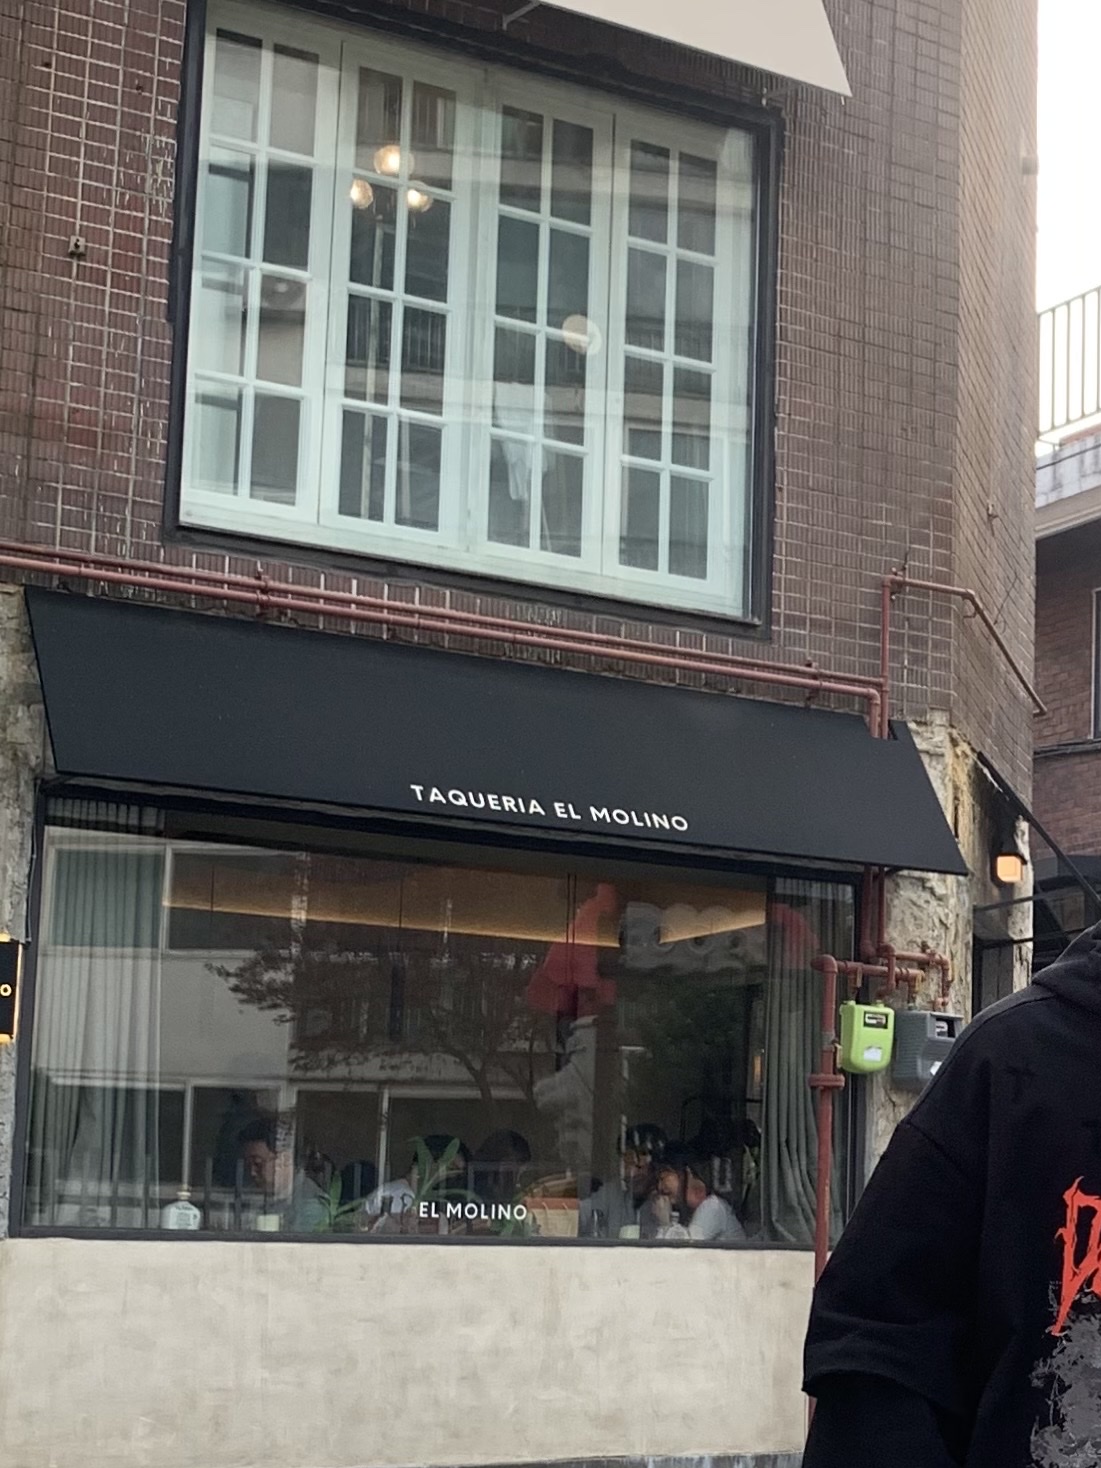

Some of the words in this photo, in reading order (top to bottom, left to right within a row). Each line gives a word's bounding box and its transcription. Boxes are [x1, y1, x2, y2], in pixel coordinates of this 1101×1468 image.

[410, 784, 545, 816] TAQUERIA
[554, 802, 582, 819] EL
[589, 806, 689, 832] MOLINO
[419, 1201, 440, 1218] EL
[446, 1202, 527, 1221] MOLINO
